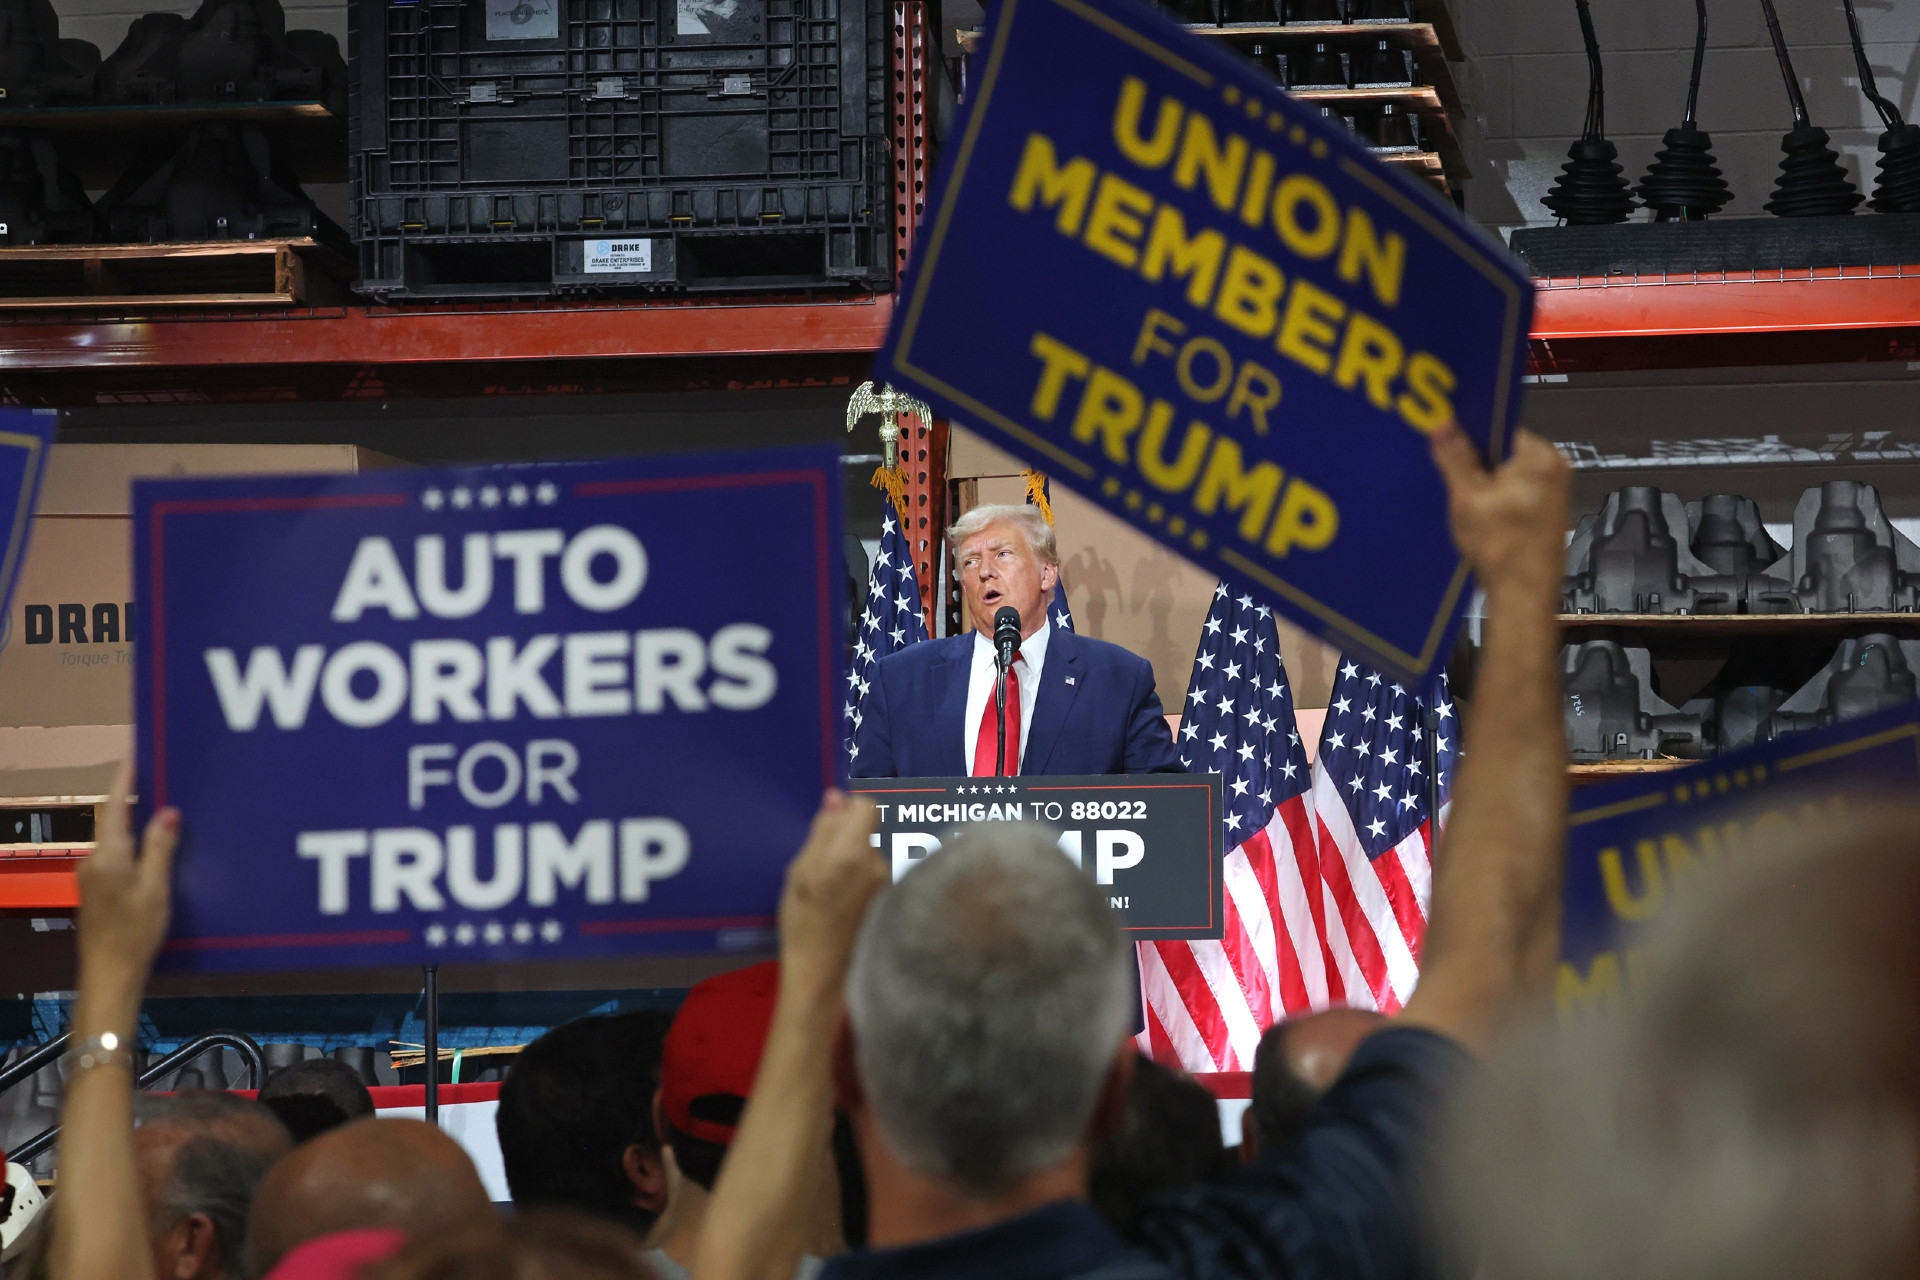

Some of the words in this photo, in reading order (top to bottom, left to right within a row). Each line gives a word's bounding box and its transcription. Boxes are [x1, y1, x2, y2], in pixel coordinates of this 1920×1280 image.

[1114, 77, 1404, 304] UNION
[611, 244, 640, 252] DRAKE
[1010, 134, 1455, 432] MEMBERS
[1134, 310, 1281, 434] FOR
[1032, 334, 1340, 556] TRUMP
[332, 525, 647, 621] AUTO
[60, 651, 110, 667] Torque
[205, 624, 776, 731] WORKERS
[408, 739, 578, 808] FOR
[898, 802, 1023, 822] MICHIGAN
[1030, 801, 1063, 821] TO
[1070, 800, 1147, 820] 88022
[296, 818, 690, 915] TRUMP
